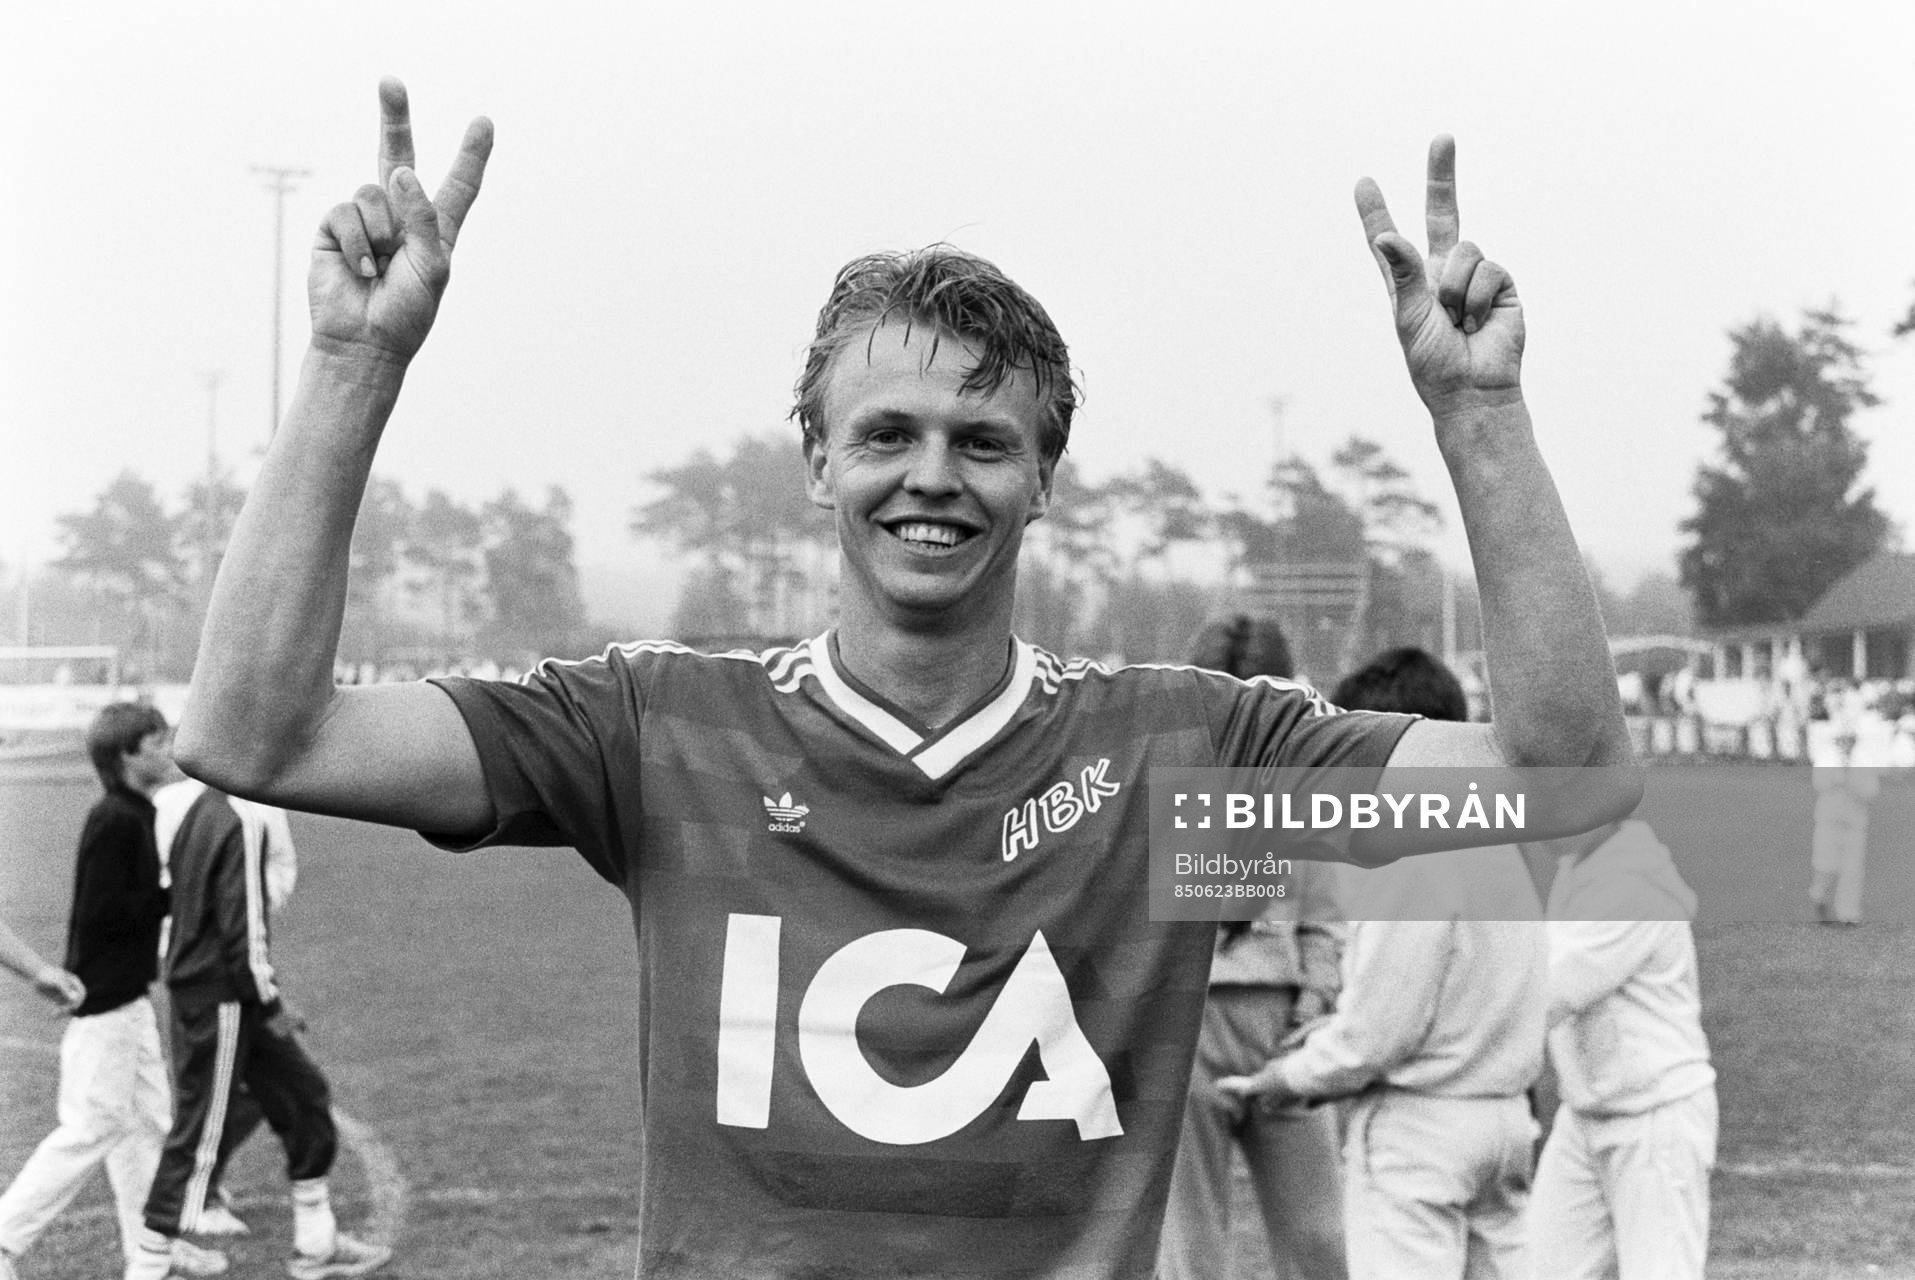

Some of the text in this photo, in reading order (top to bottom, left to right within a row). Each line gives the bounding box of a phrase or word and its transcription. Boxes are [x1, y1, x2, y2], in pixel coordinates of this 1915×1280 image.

[768, 822, 801, 833] adidas
[1002, 758, 1121, 862] HBK
[716, 912, 1125, 1145] ICA
